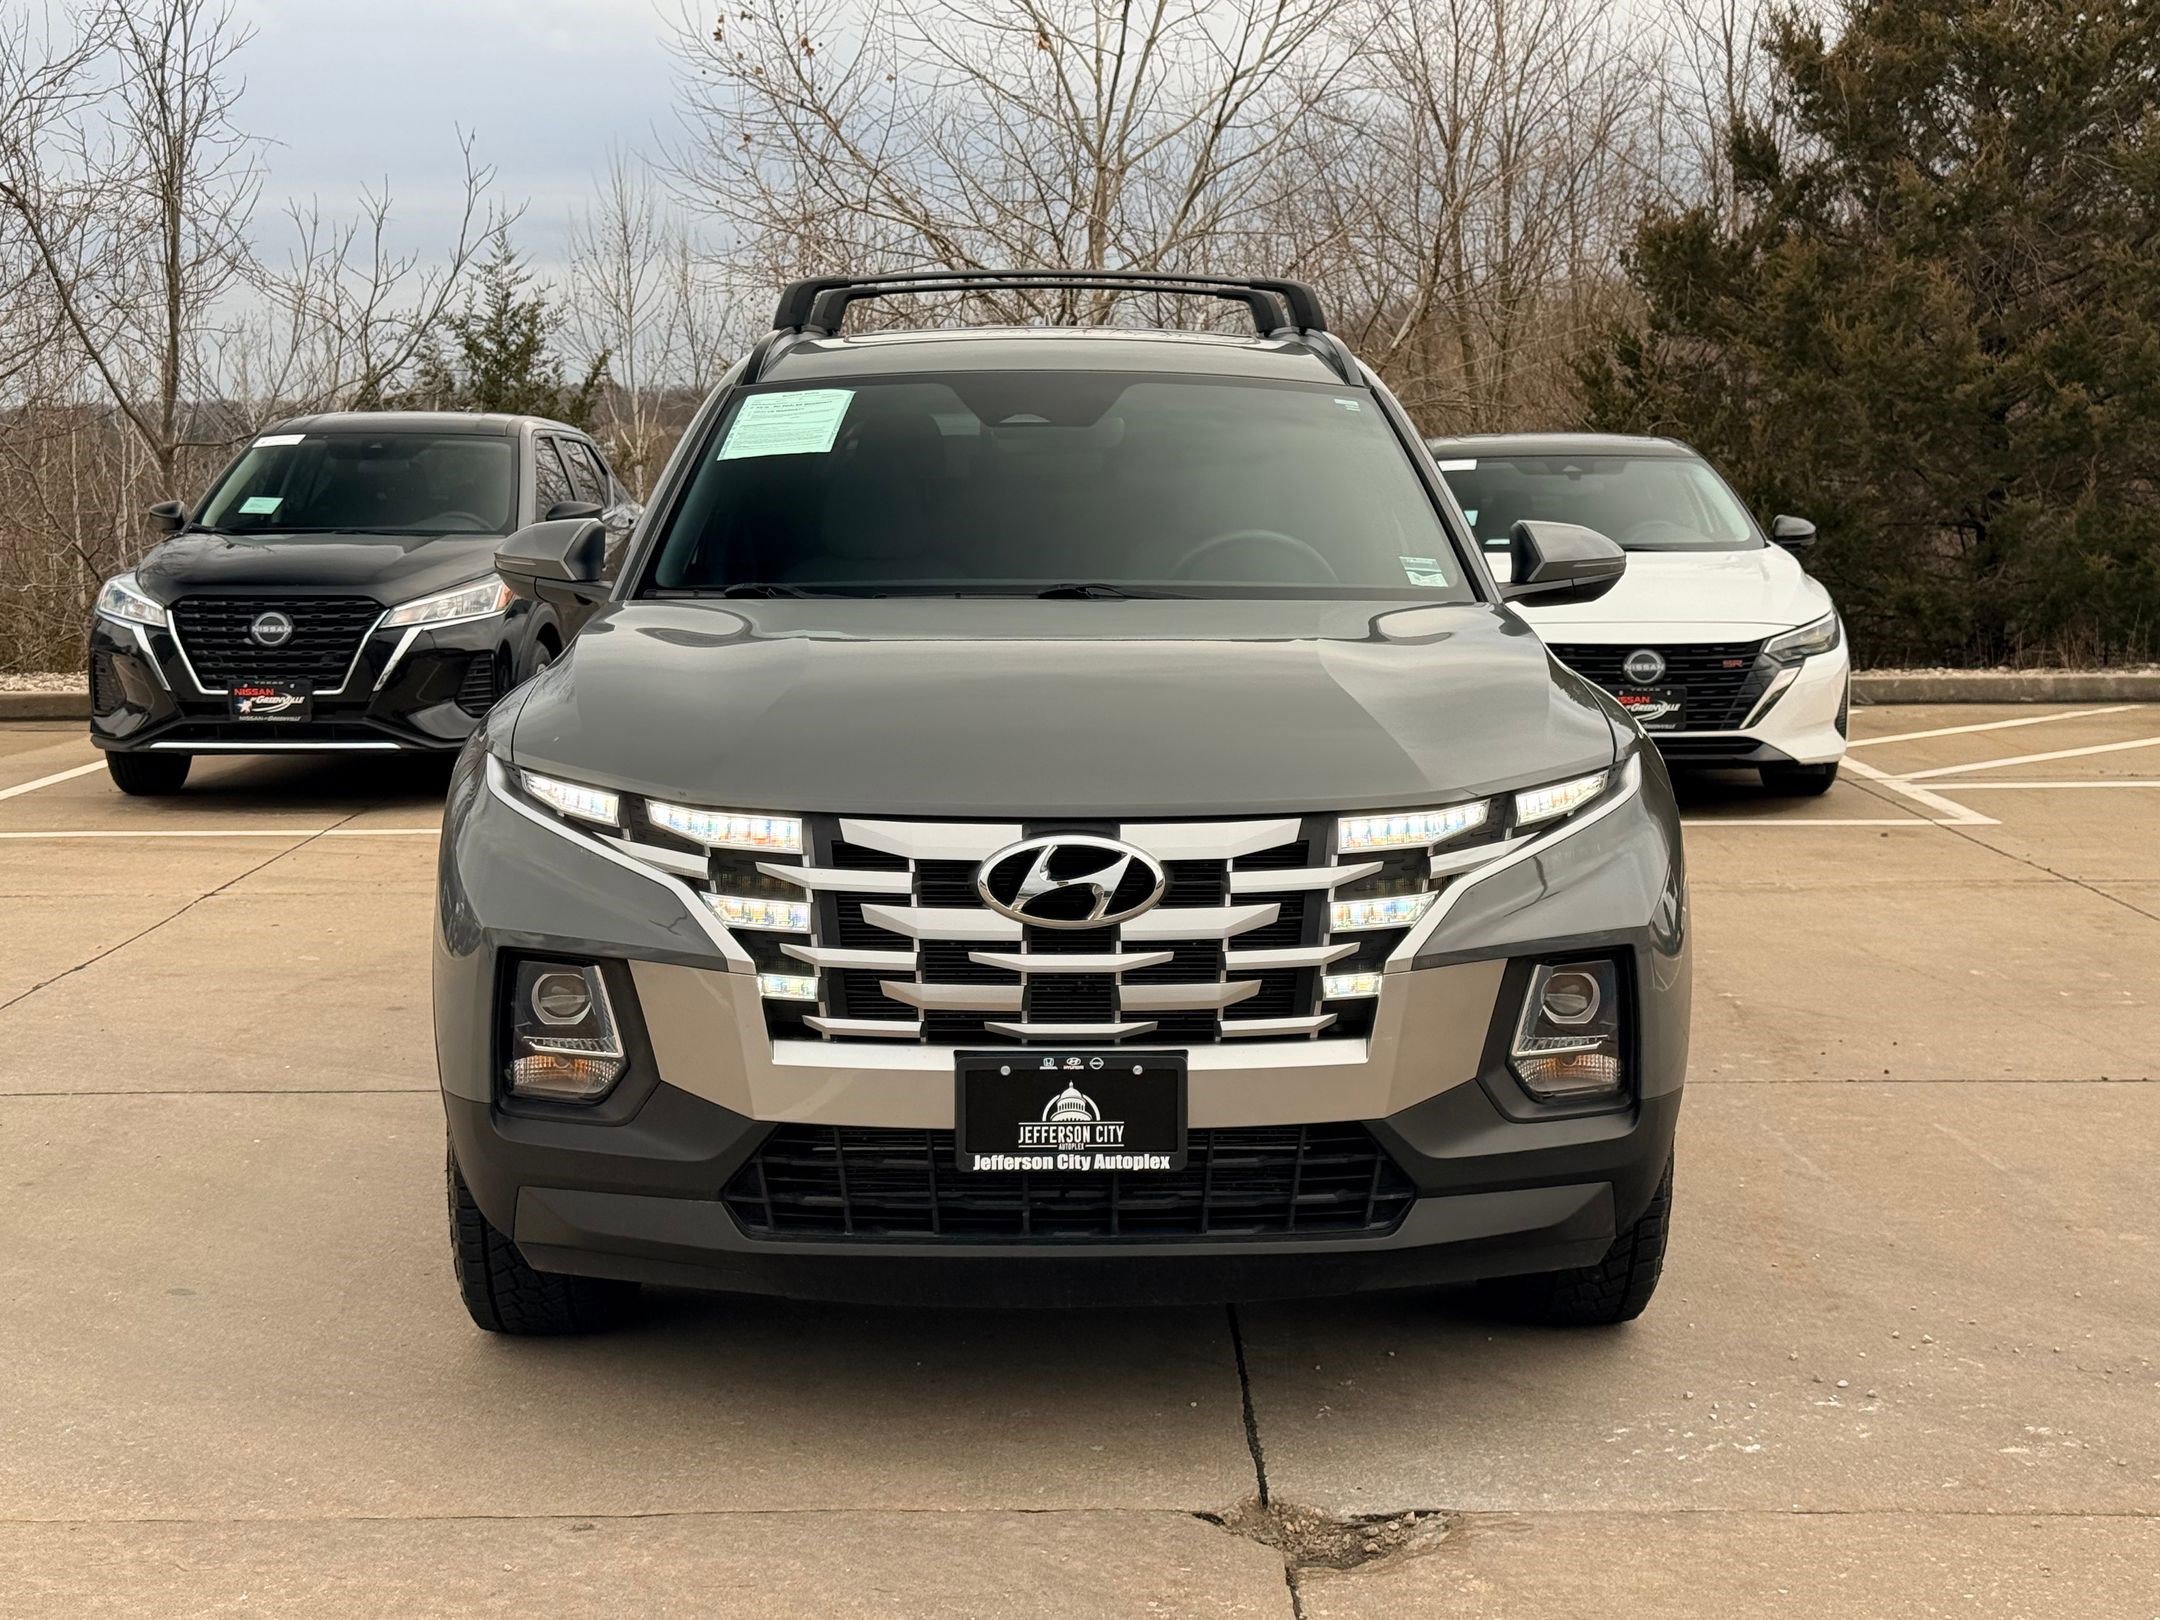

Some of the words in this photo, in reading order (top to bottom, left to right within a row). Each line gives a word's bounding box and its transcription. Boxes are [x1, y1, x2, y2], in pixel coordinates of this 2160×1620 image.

[252, 625, 292, 633] NISSAN
[1624, 664, 1665, 672] NISSAN
[234, 688, 274, 696] NISSAN
[1018, 1125, 1091, 1144] JEFFERSON
[1096, 1125, 1125, 1143] CITY
[973, 1154, 1053, 1171] Jefferson
[1057, 1154, 1091, 1171] City
[1094, 1154, 1170, 1171] Autoplex
